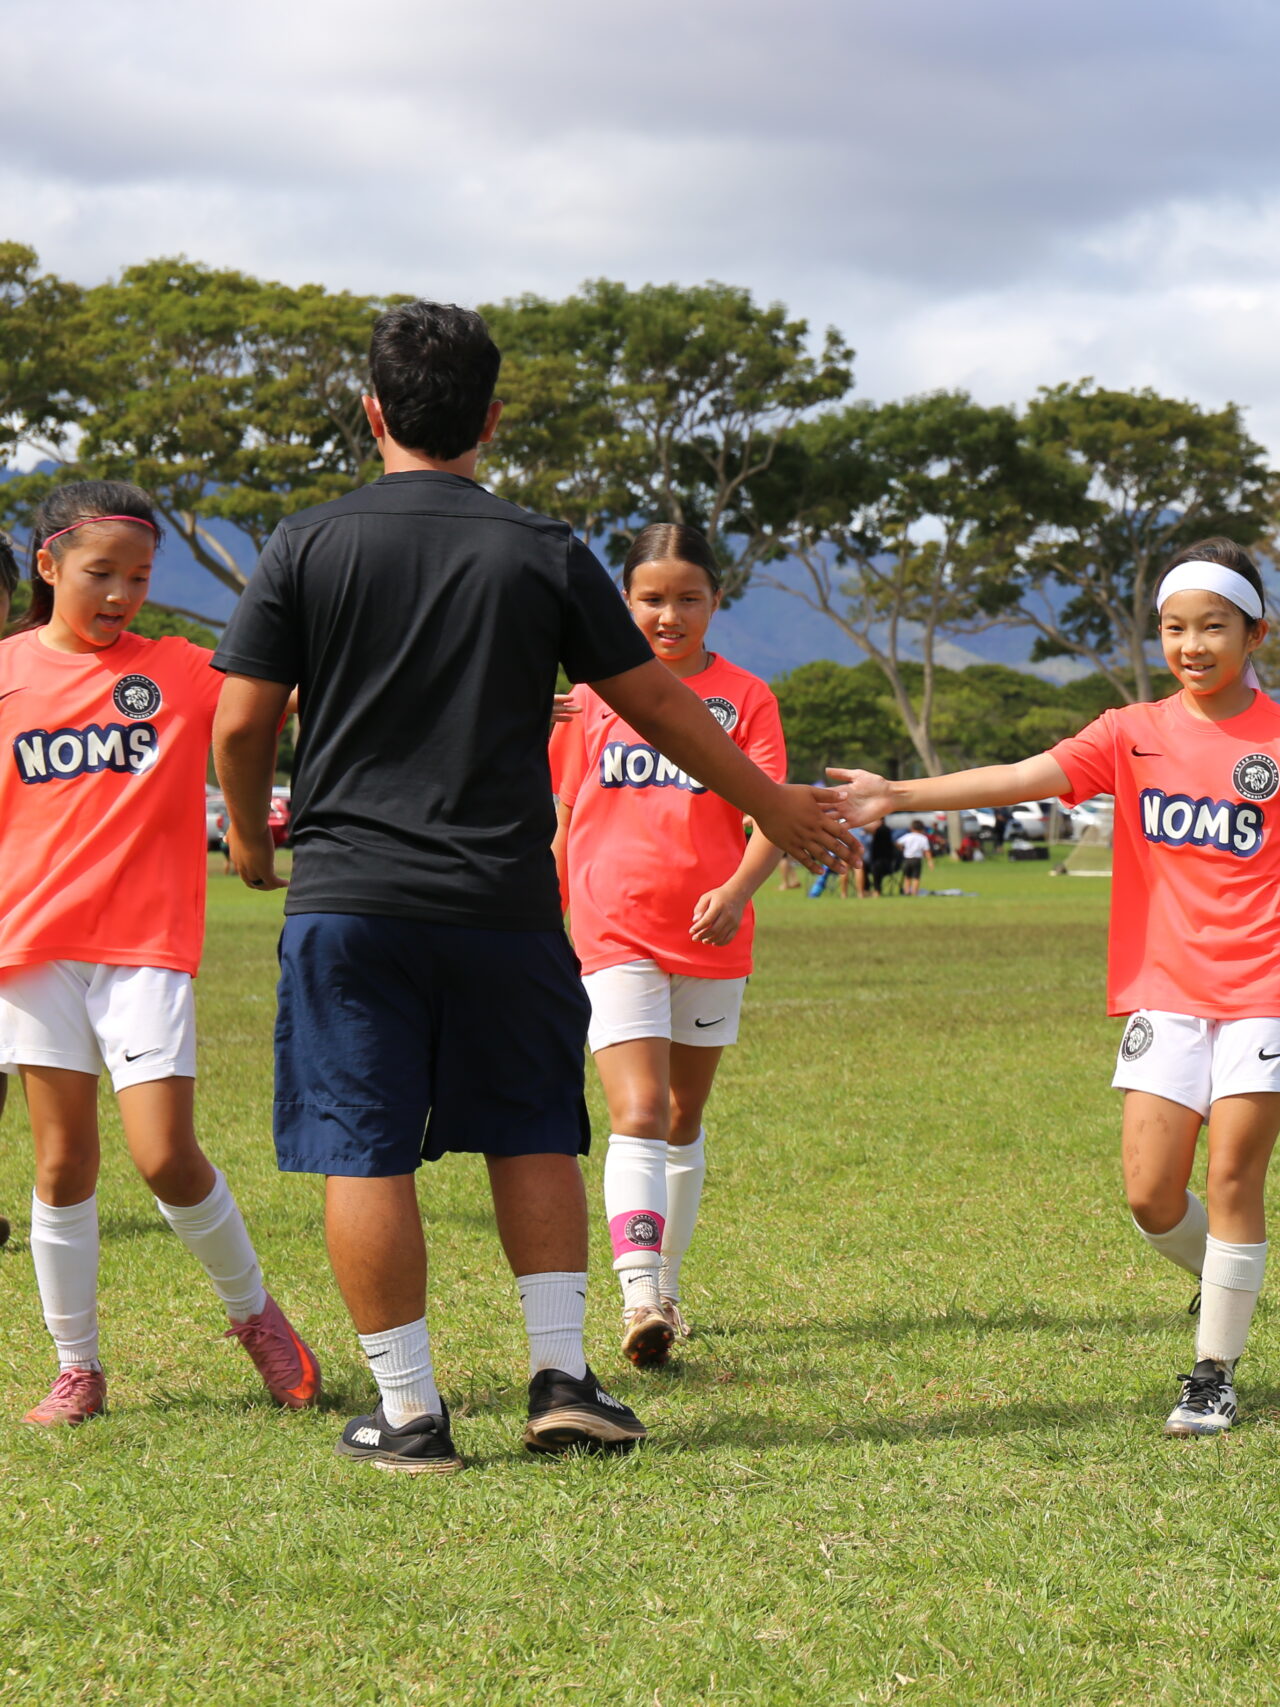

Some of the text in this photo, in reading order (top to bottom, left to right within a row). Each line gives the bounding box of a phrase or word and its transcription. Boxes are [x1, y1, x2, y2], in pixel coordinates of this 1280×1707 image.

[17, 727, 154, 778] NOMS
[603, 746, 705, 788] NOM
[1143, 795, 1257, 851] NOMS
[351, 1426, 382, 1447] HOKA
